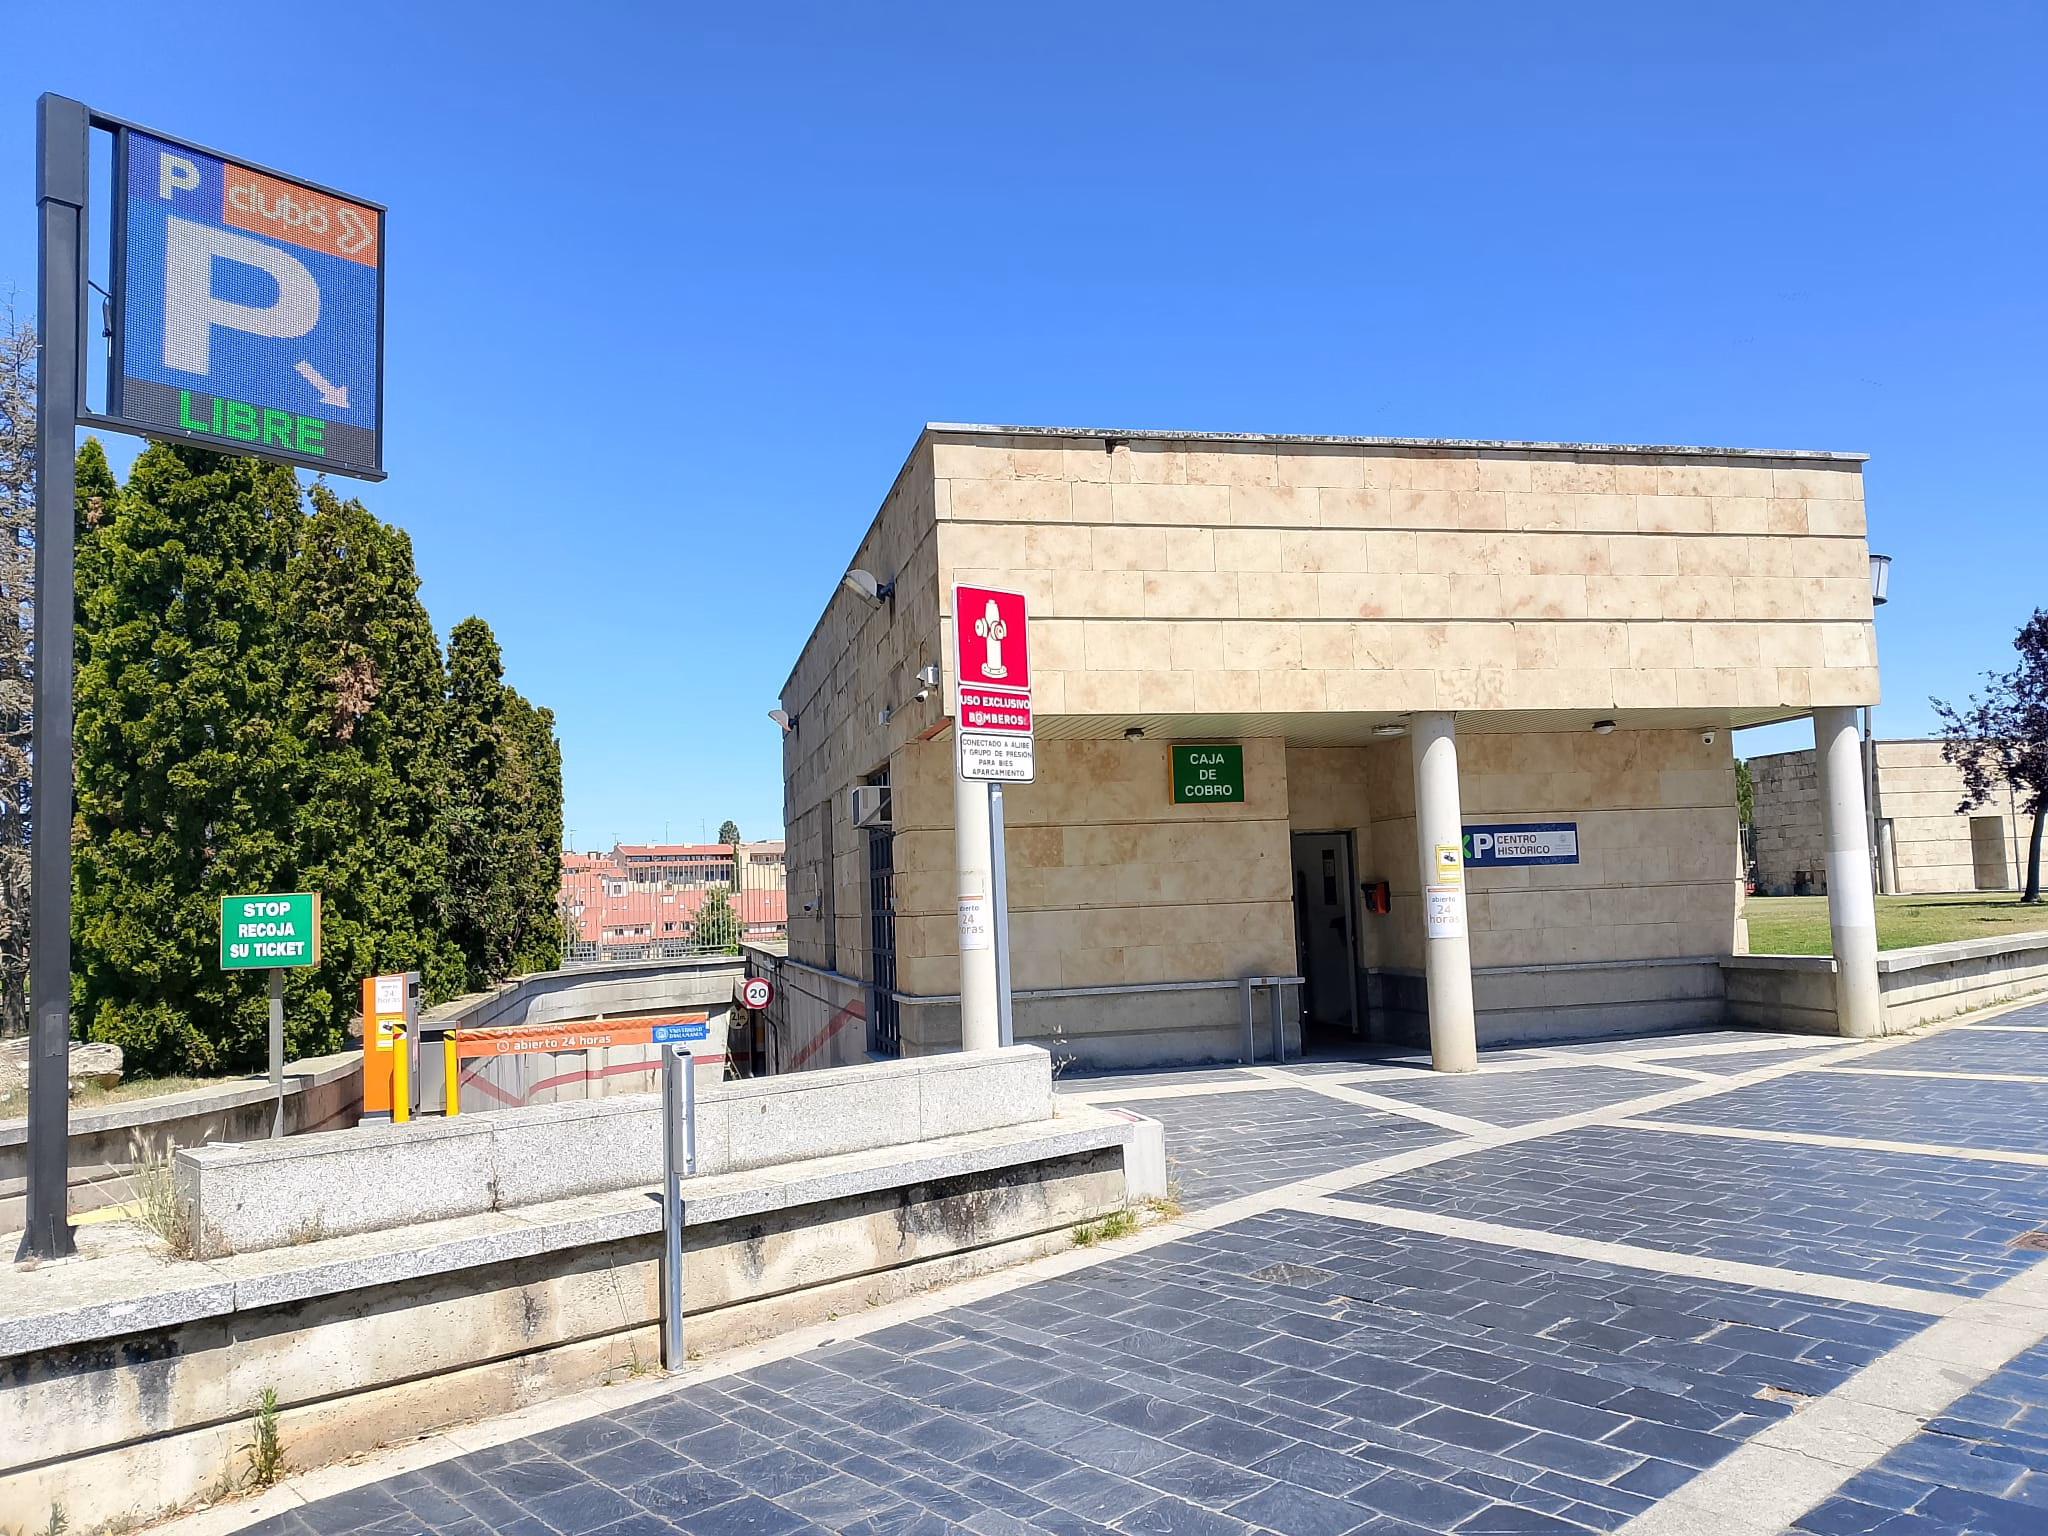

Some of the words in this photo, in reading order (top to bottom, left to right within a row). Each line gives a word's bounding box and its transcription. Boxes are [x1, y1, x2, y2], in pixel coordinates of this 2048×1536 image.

[159, 152, 200, 200] P
[164, 215, 321, 375] P
[180, 390, 326, 456] LIBRE
[961, 695, 980, 705] USO
[983, 696, 1030, 709] EXCLUSIVO
[968, 712, 1023, 725] BOMBEROS
[963, 739, 1001, 748] CONECTADO
[1011, 741, 1030, 749] ALJIBE
[970, 749, 991, 757] GRUPO
[1190, 753, 1225, 765] CAJA
[973, 769, 1025, 777] APARCAMIENTO
[1200, 769, 1217, 780] DE
[1185, 784, 1232, 796] COBRO
[1473, 833, 1494, 859] P
[1497, 835, 1537, 845] CENTRO
[1498, 843, 1550, 855] HISTÓRICO
[243, 901, 291, 918] STOP
[1437, 904, 1452, 915] 24
[962, 914, 975, 924] 24
[1429, 913, 1461, 924] horas
[238, 922, 295, 938] RECOJA
[230, 943, 249, 958] SU
[253, 941, 304, 957] TICKET
[750, 988, 766, 999] 20
[513, 1038, 558, 1050] abierto
[561, 1036, 576, 1047] 24
[579, 1034, 612, 1045] horas
